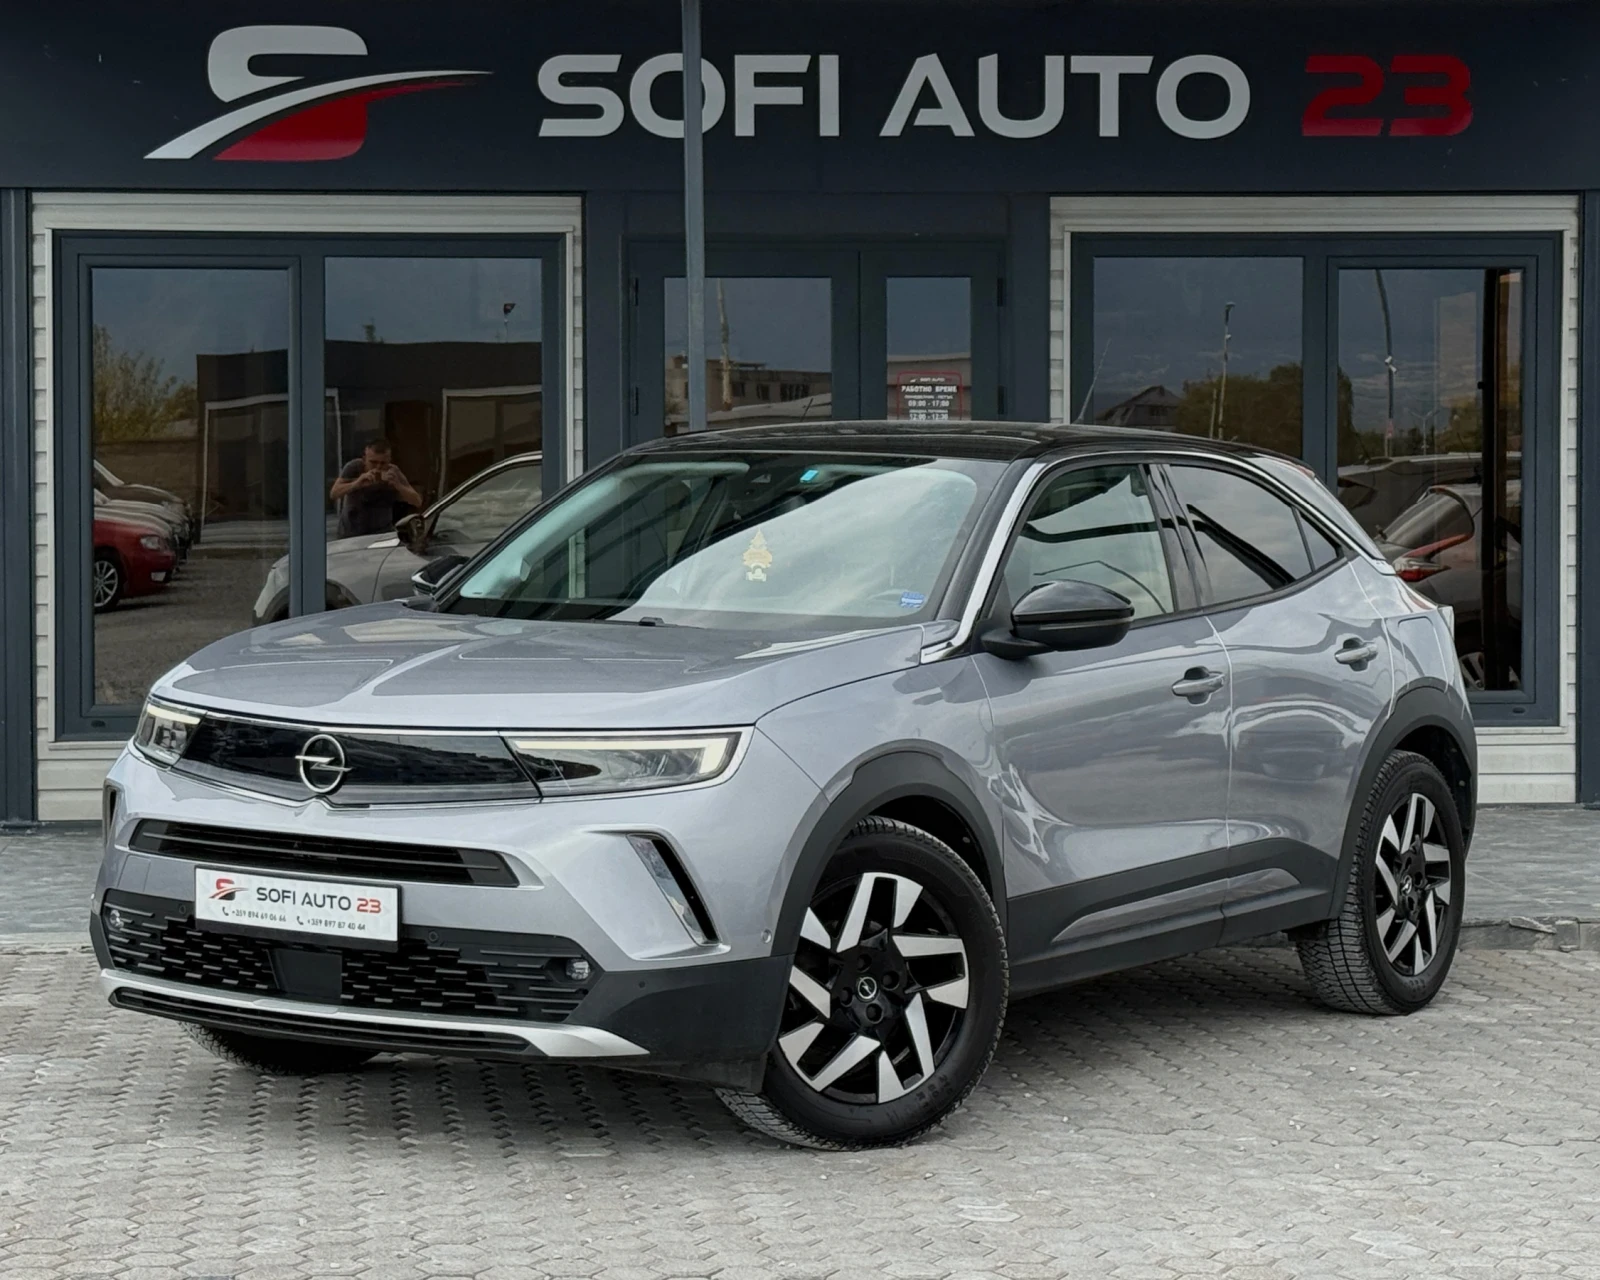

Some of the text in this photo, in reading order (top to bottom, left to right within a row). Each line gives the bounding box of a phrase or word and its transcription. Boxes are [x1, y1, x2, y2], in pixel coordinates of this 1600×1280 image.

[538, 53, 1473, 139] SOFI AUTO 23
[256, 887, 382, 914] SOFI AUTO 23
